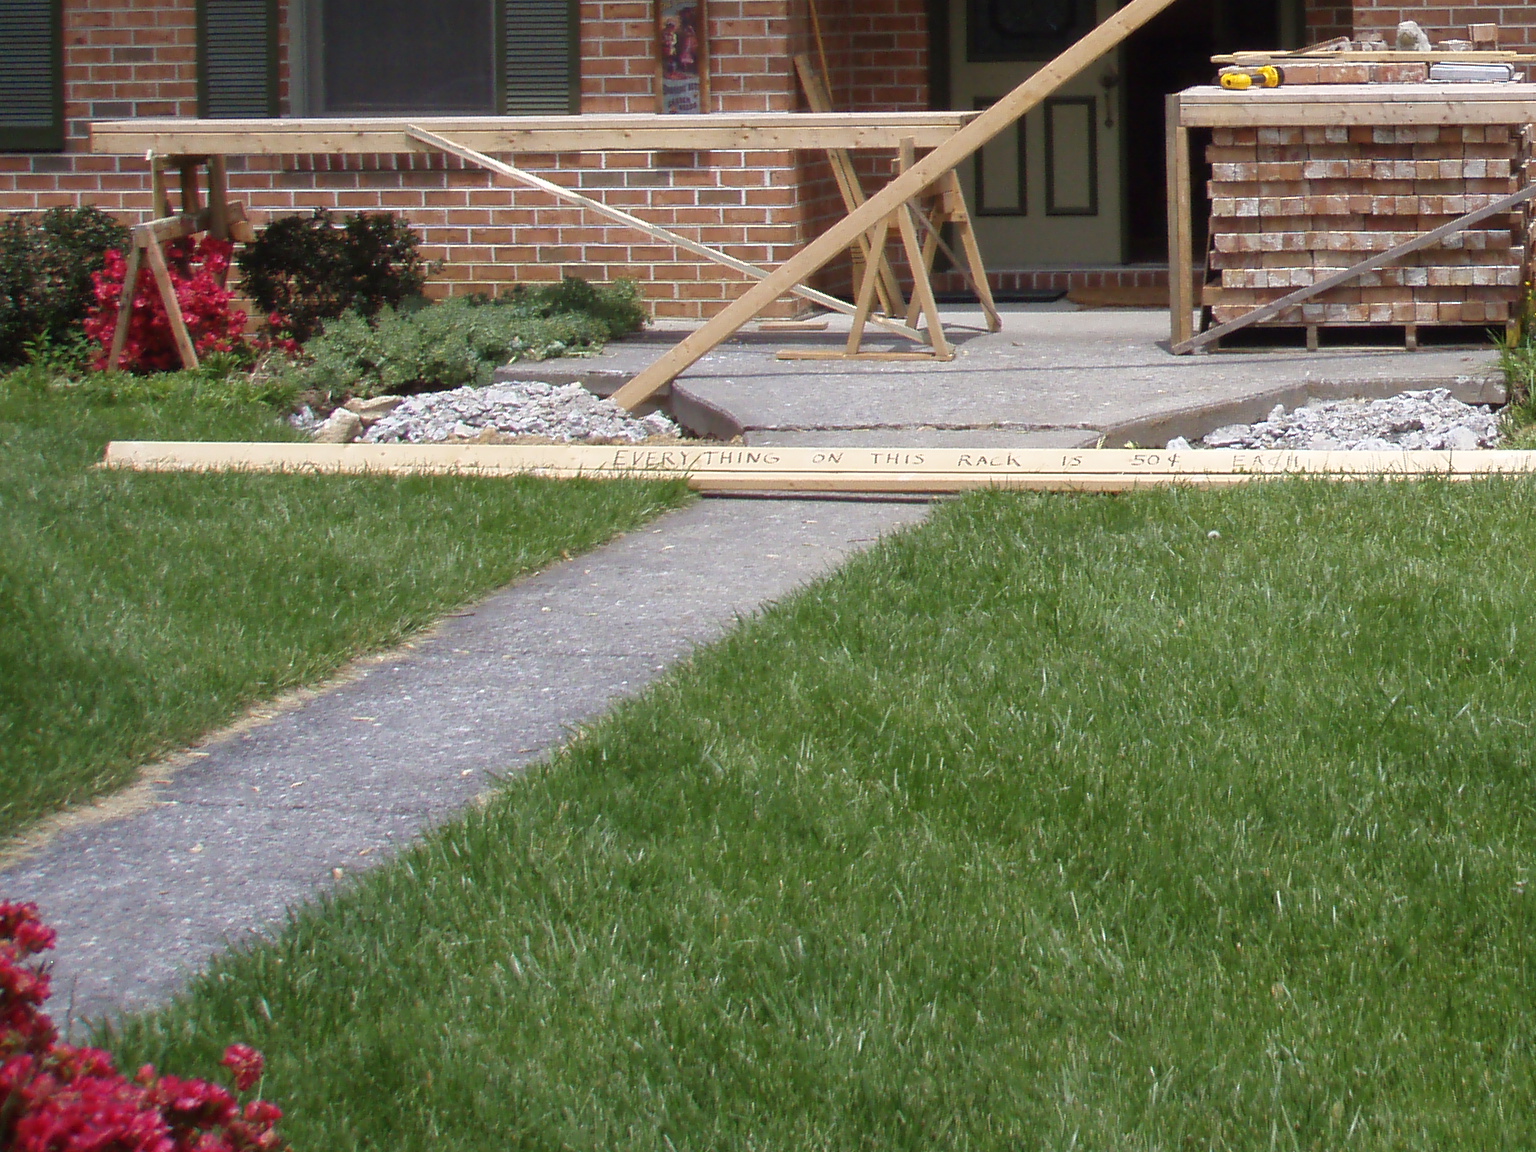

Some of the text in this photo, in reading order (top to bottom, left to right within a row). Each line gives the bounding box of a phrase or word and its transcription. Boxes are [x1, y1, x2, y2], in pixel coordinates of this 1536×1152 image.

[612, 449, 781, 467] EVERYTHING
[812, 451, 844, 465] ON
[870, 452, 926, 466] THIS
[957, 452, 1023, 467] RACK
[1060, 454, 1083, 467] IS
